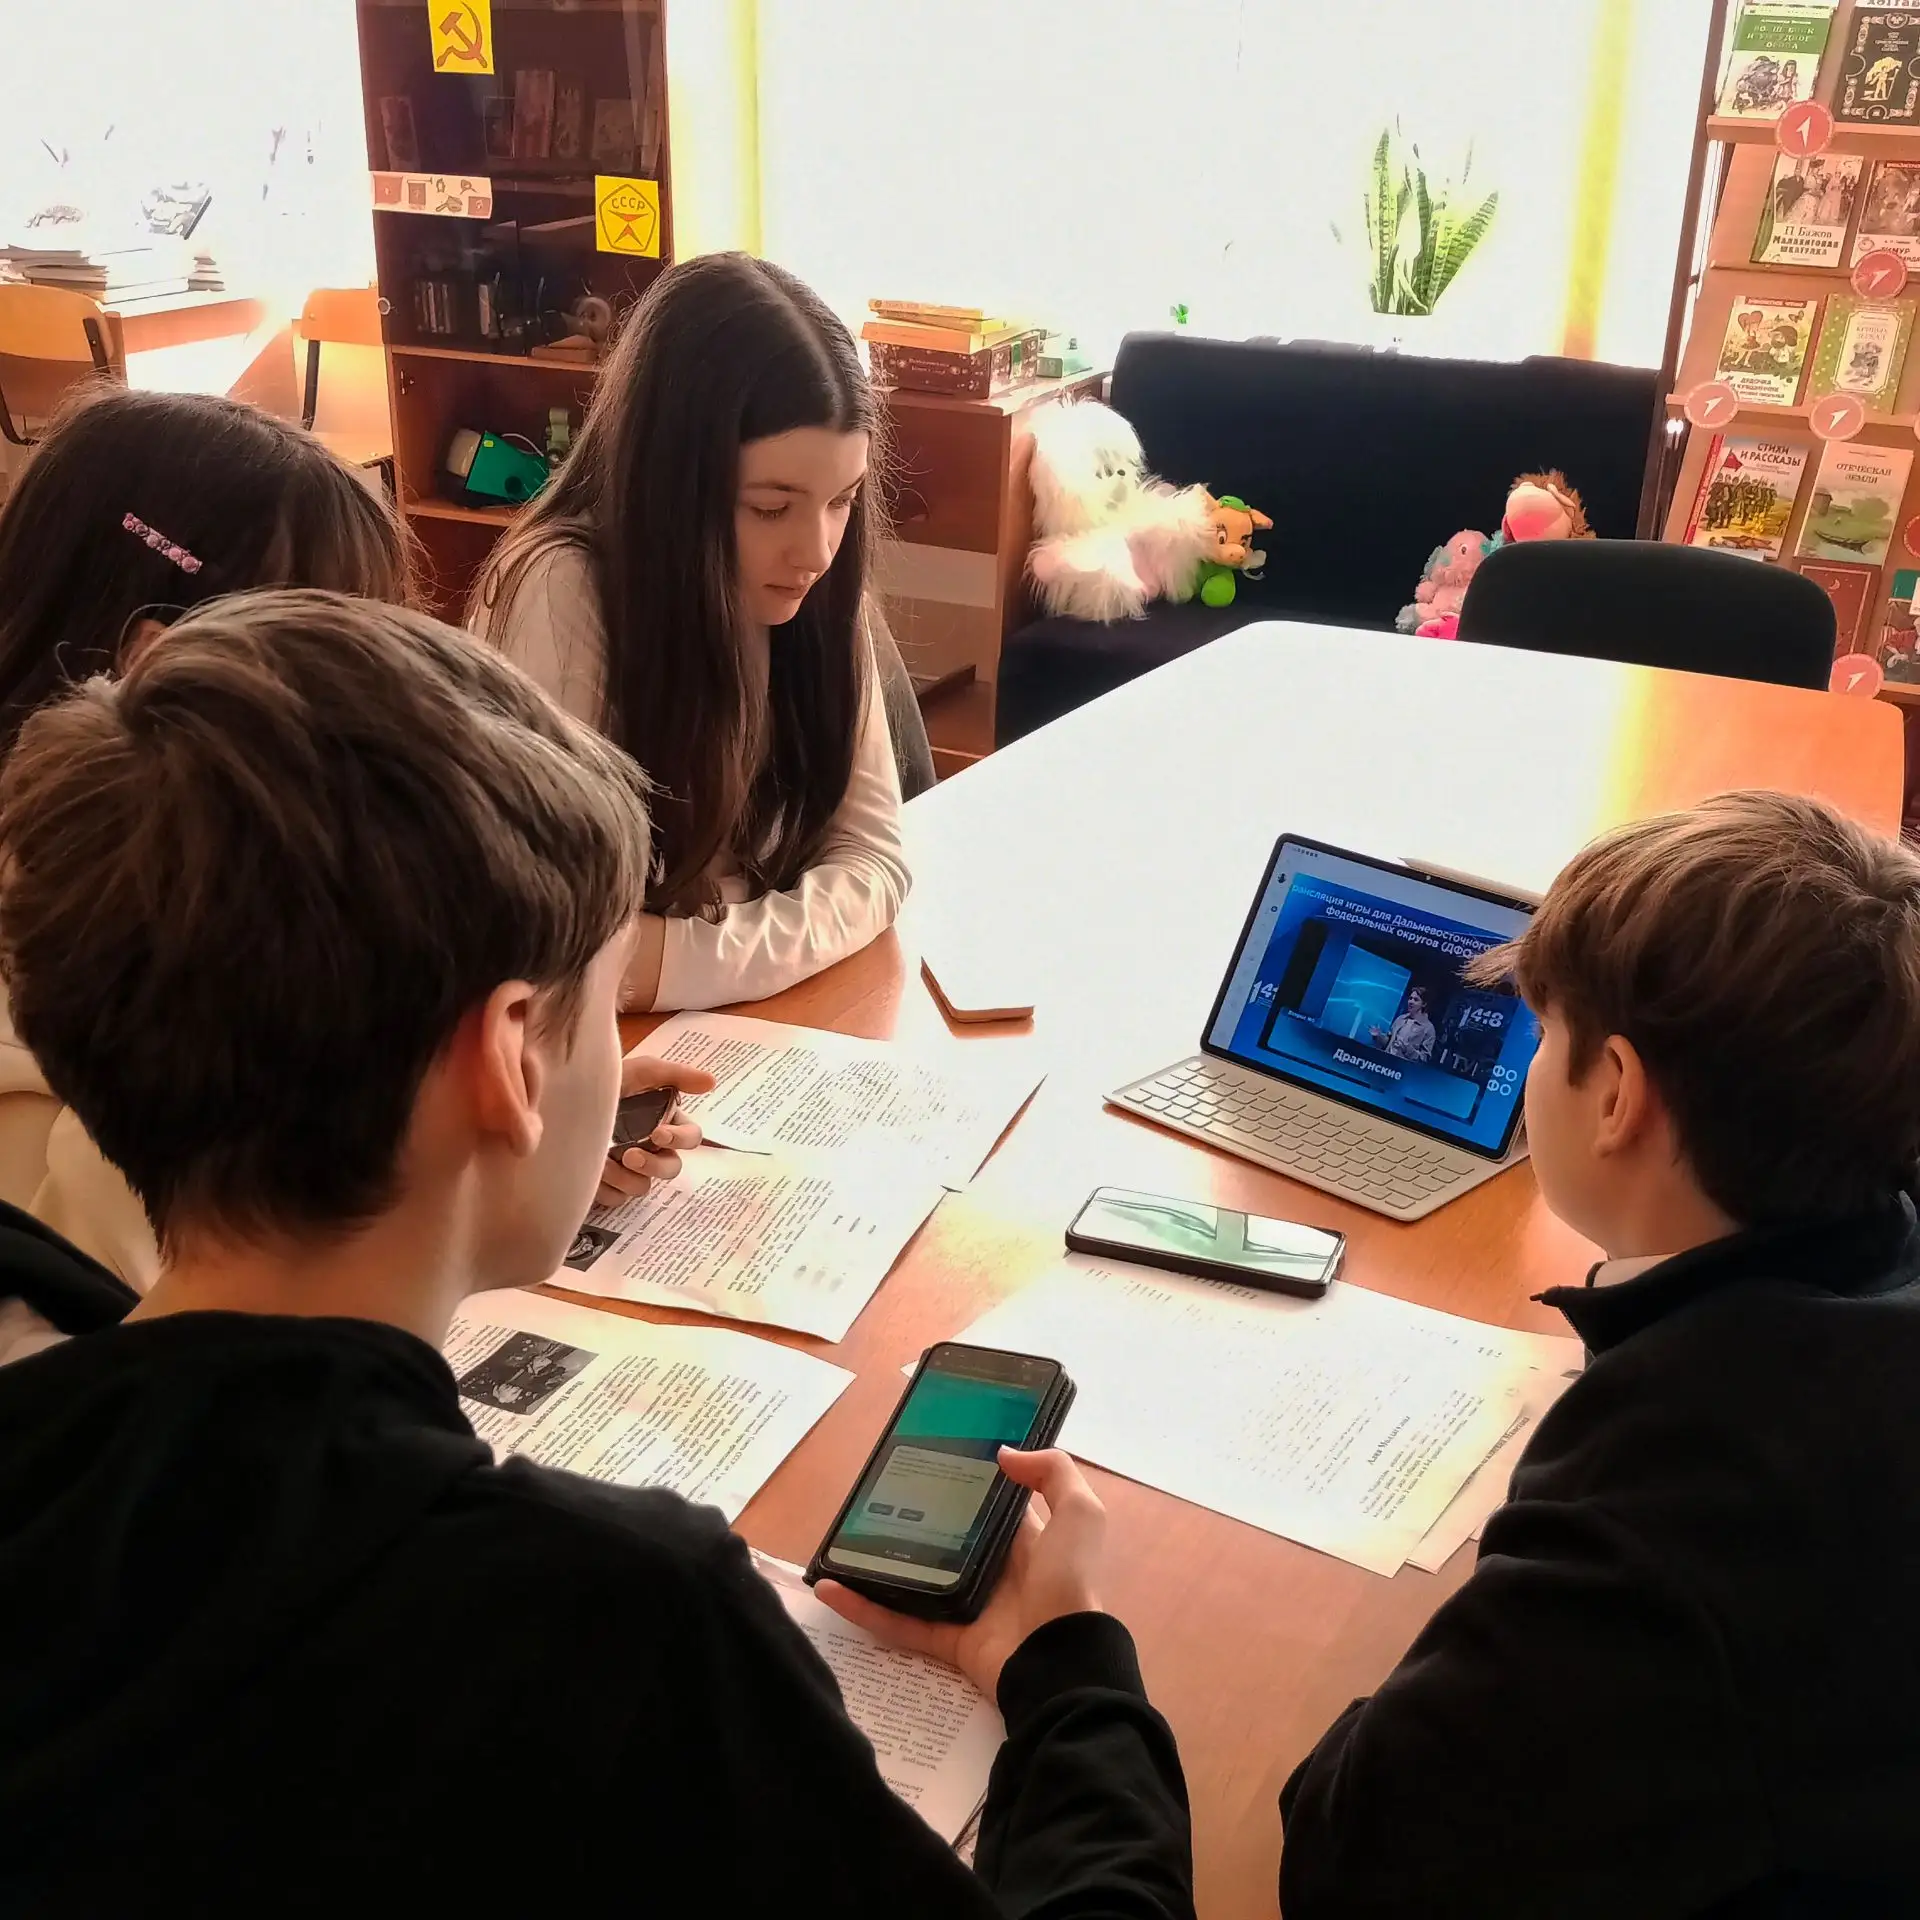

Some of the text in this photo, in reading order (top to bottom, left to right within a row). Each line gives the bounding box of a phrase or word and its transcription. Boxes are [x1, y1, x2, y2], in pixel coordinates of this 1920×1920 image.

[611, 195, 647, 212] СССР
[1797, 226, 1832, 239] Бажов
[1757, 442, 1790, 455] СТИХИ
[1740, 450, 1801, 467] И РАССКАЗЫ
[1291, 882, 1495, 951] рансляция игры для Дальневосточного
[1325, 905, 1395, 934] федеральных
[1396, 926, 1440, 949] округов
[1332, 1048, 1402, 1080] Драгунские
